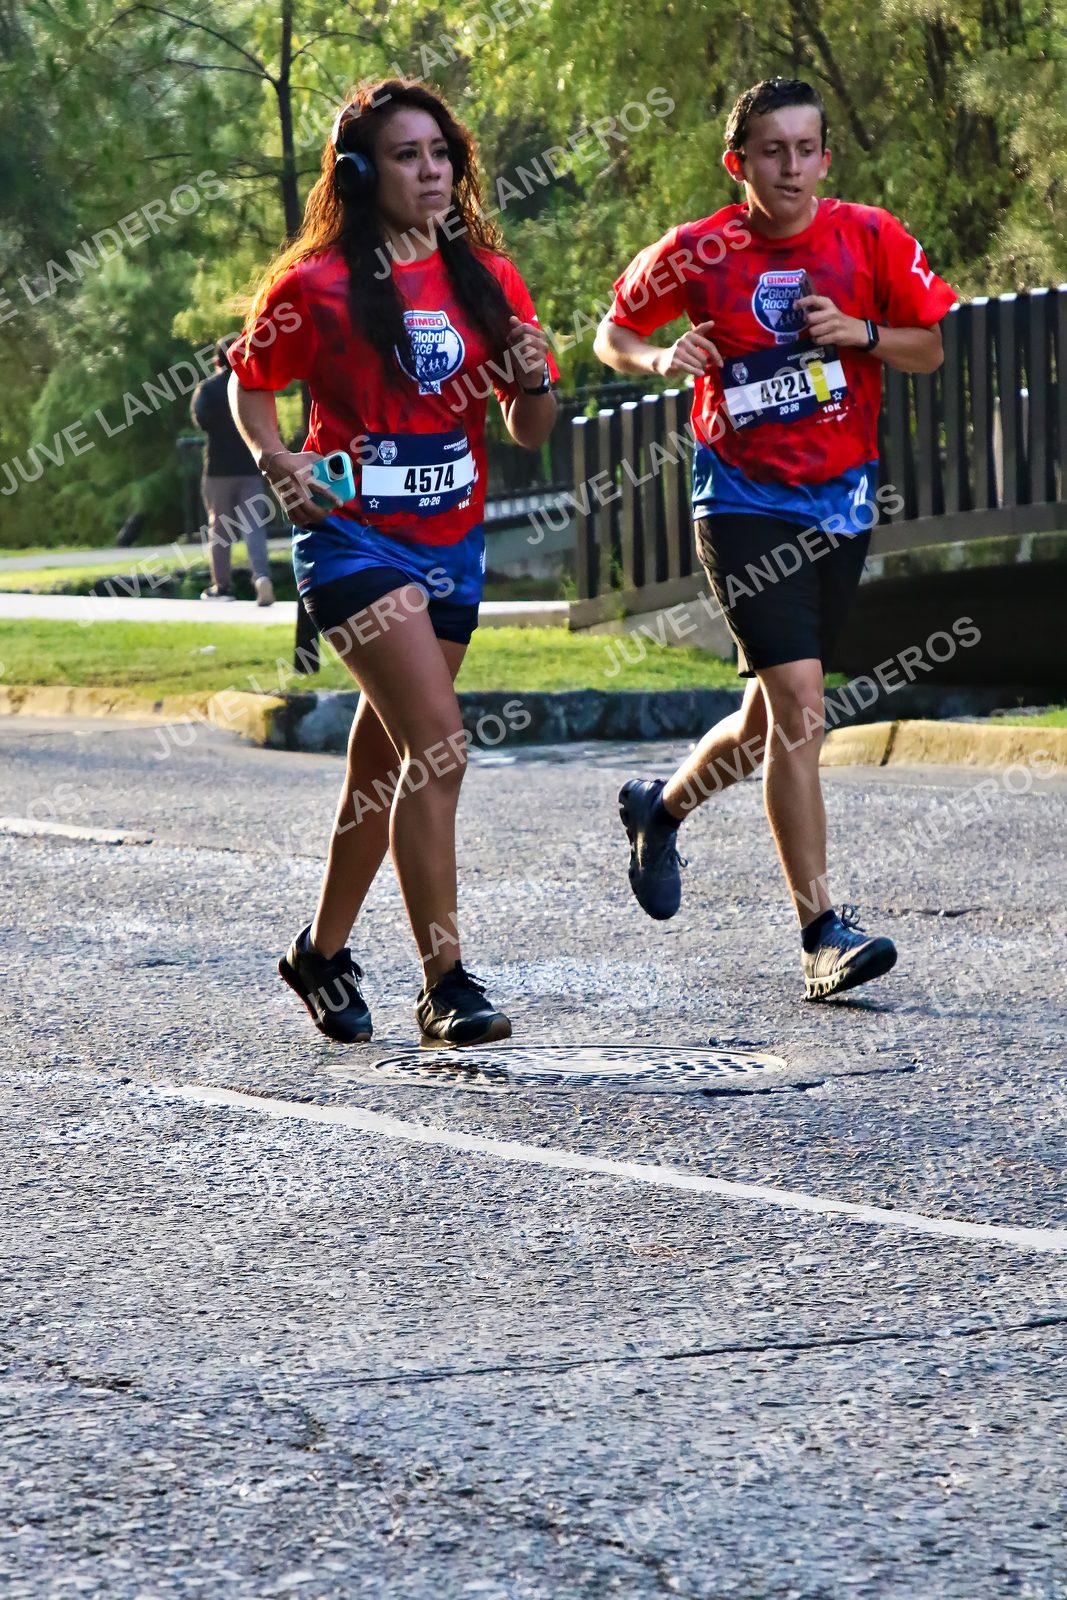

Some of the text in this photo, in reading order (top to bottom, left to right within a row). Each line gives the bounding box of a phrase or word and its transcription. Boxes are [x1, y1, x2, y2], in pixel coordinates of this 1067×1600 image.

[767, 276, 800, 284] BIMBO
[769, 288, 801, 300] Global
[762, 298, 789, 309] Race
[407, 318, 443, 326] BIMBO
[411, 330, 445, 344] Global
[760, 372, 811, 405] 4224
[822, 403, 841, 413] 10K
[404, 464, 455, 493] 4574
[458, 498, 470, 510] 10K
